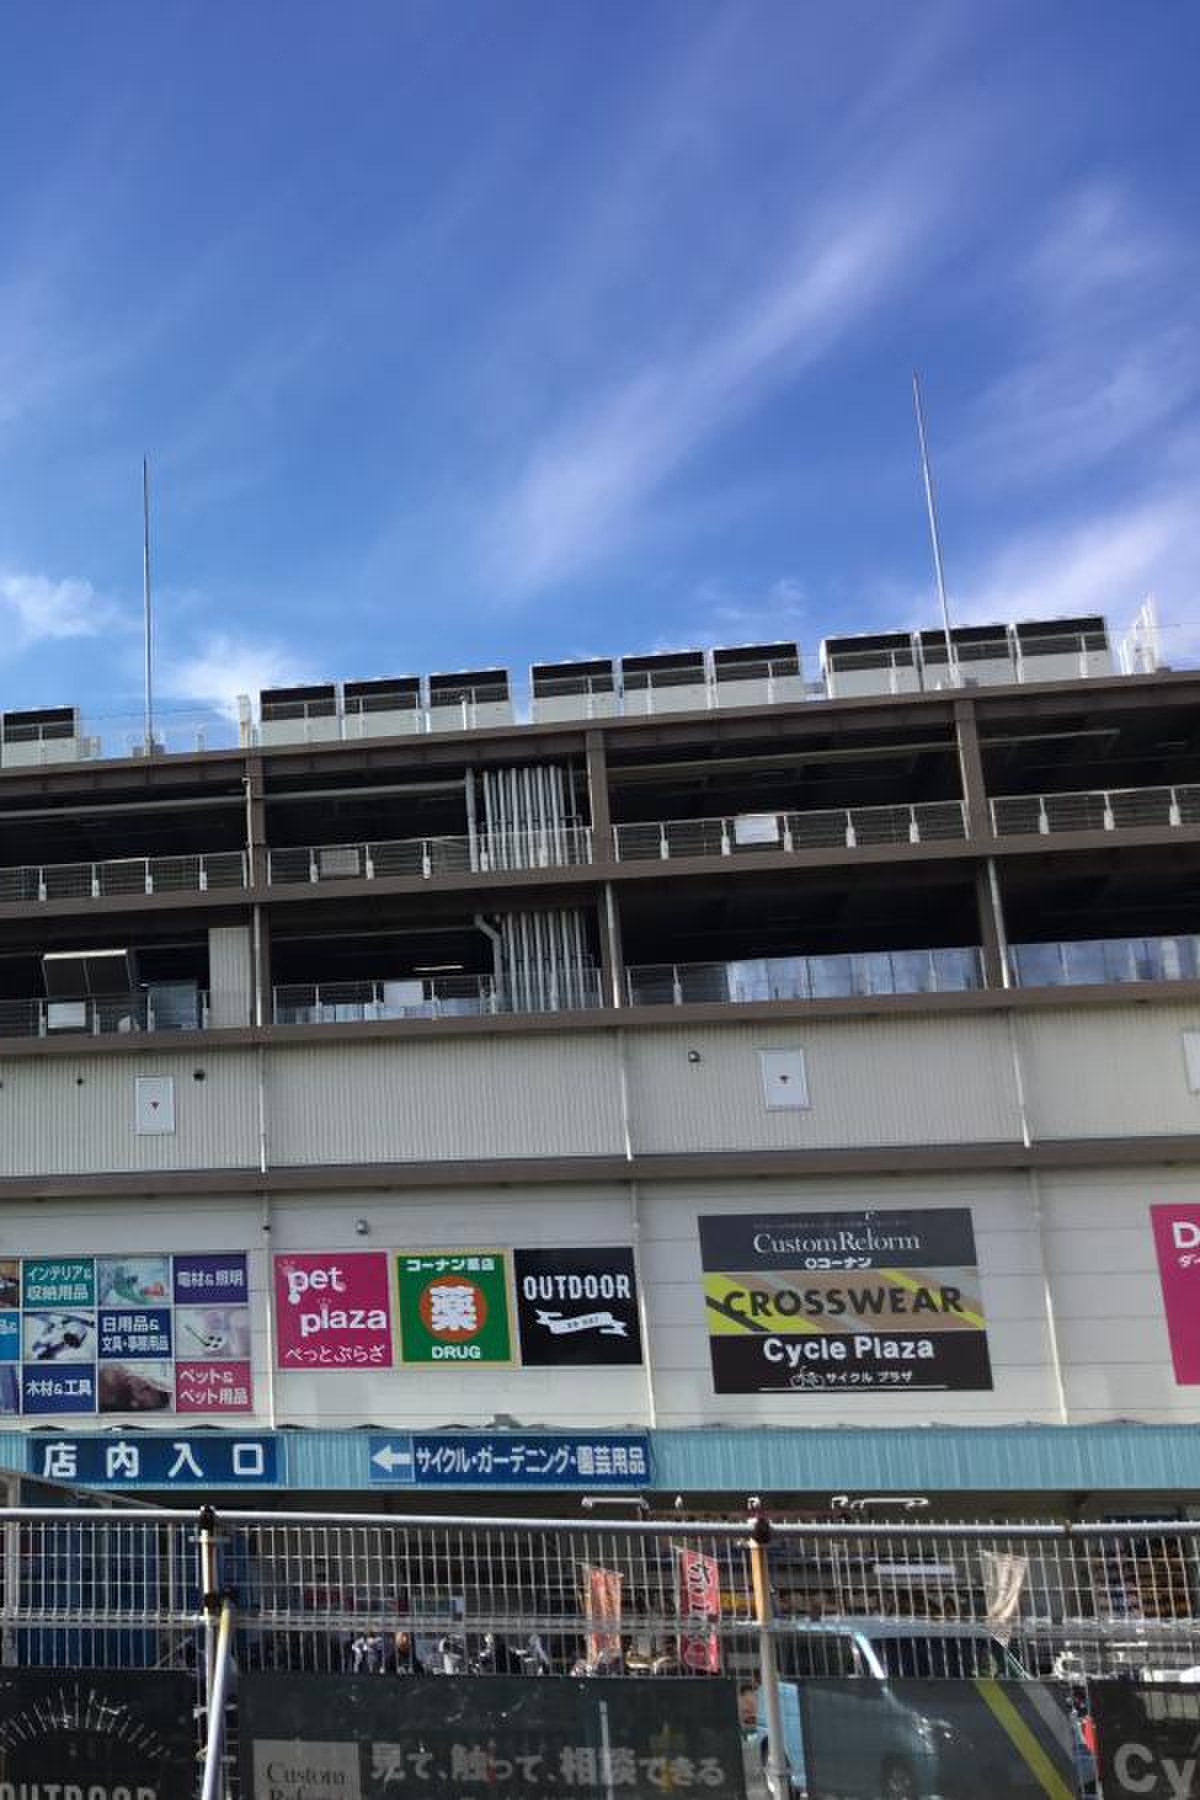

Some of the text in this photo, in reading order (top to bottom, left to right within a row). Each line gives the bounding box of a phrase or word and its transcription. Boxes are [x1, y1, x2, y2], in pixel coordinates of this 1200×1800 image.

[286, 1266, 346, 1304] pet
[523, 1275, 631, 1301] OUTDOOR
[719, 1286, 963, 1318] CROSSWEAR
[300, 1300, 387, 1337] plaza
[431, 1345, 481, 1360] DRUG
[763, 1336, 934, 1368] Cycle Plaza
[43, 1443, 264, 1479] 店内入口
